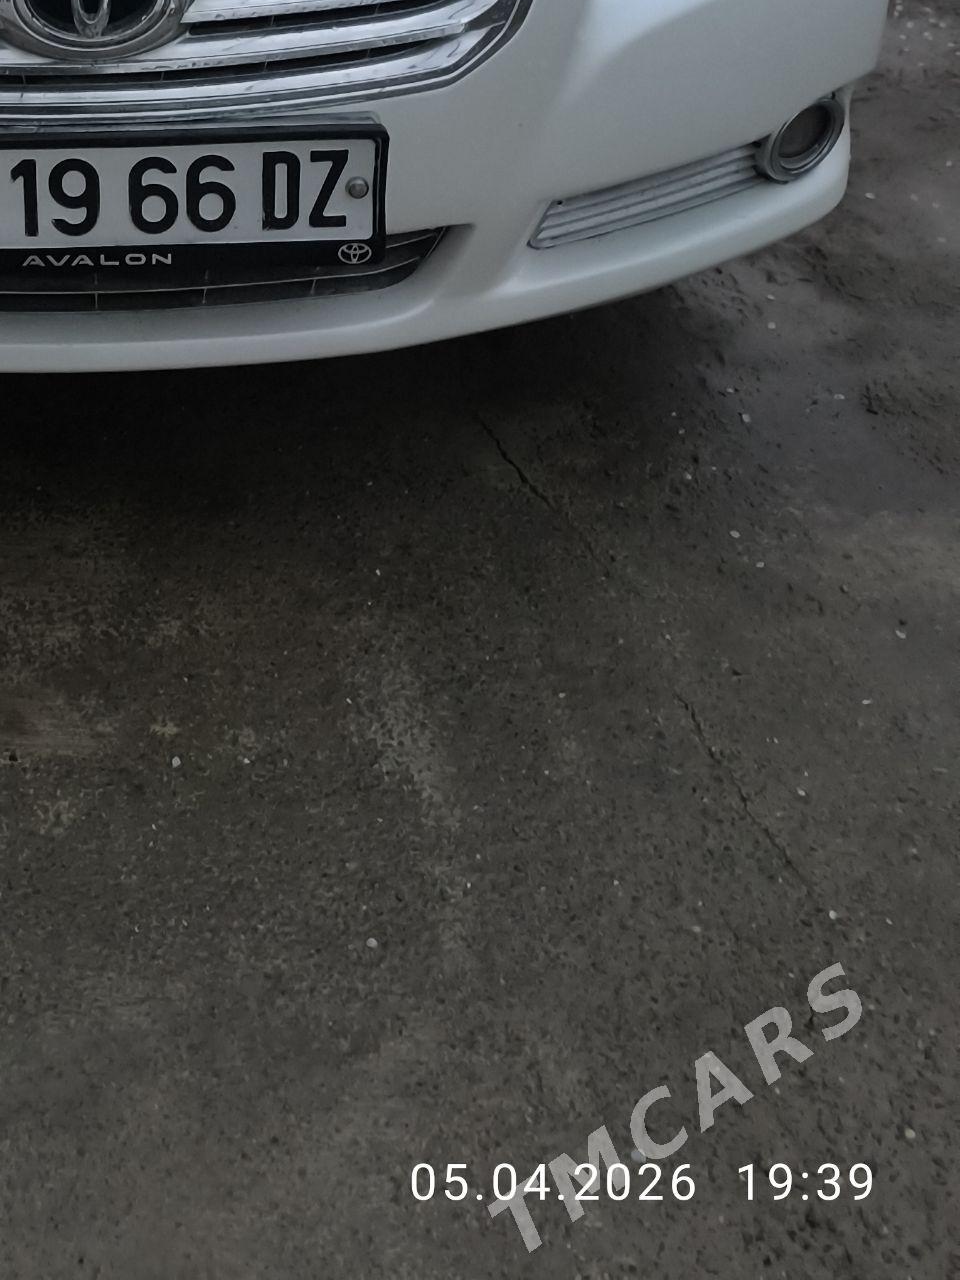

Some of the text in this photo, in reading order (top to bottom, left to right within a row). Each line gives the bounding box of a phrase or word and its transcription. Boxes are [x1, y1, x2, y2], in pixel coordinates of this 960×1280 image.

[10, 158, 100, 237] 19
[128, 155, 236, 235] 66
[261, 149, 349, 230] DZ
[21, 252, 173, 268] AVALON
